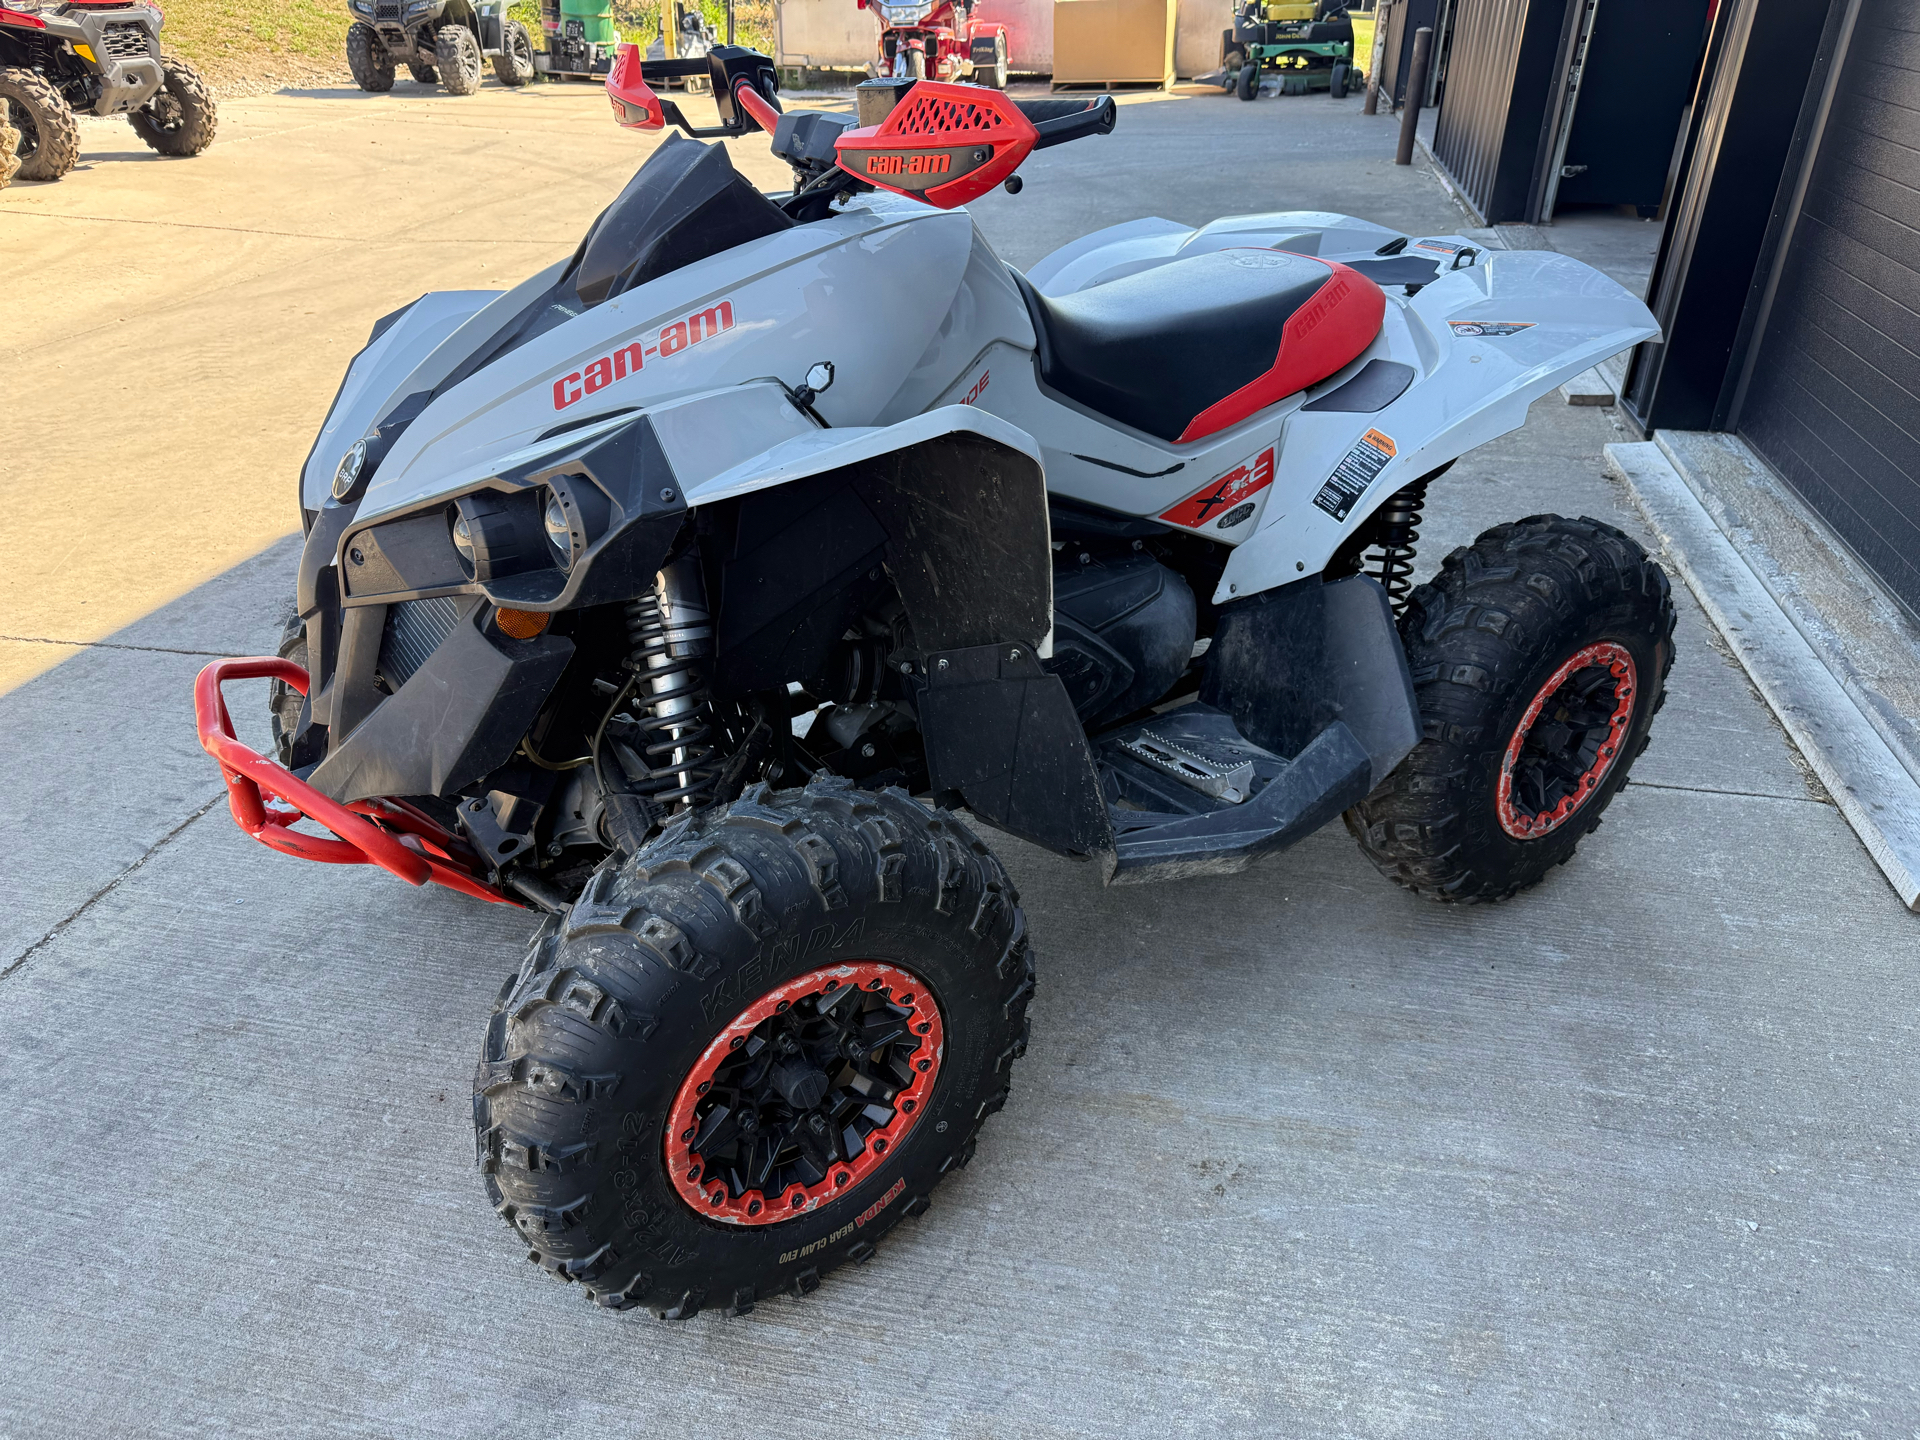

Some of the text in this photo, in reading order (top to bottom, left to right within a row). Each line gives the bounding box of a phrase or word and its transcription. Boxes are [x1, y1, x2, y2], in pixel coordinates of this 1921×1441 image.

[867, 153, 951, 175] can-am
[1294, 281, 1351, 341] can-am
[553, 300, 734, 411] can-am
[1371, 434, 1394, 451] WARNING
[338, 468, 352, 483] BRP
[699, 917, 866, 1024] KENDA
[778, 1177, 907, 1265] KENDA BEAR CLAW EVO
